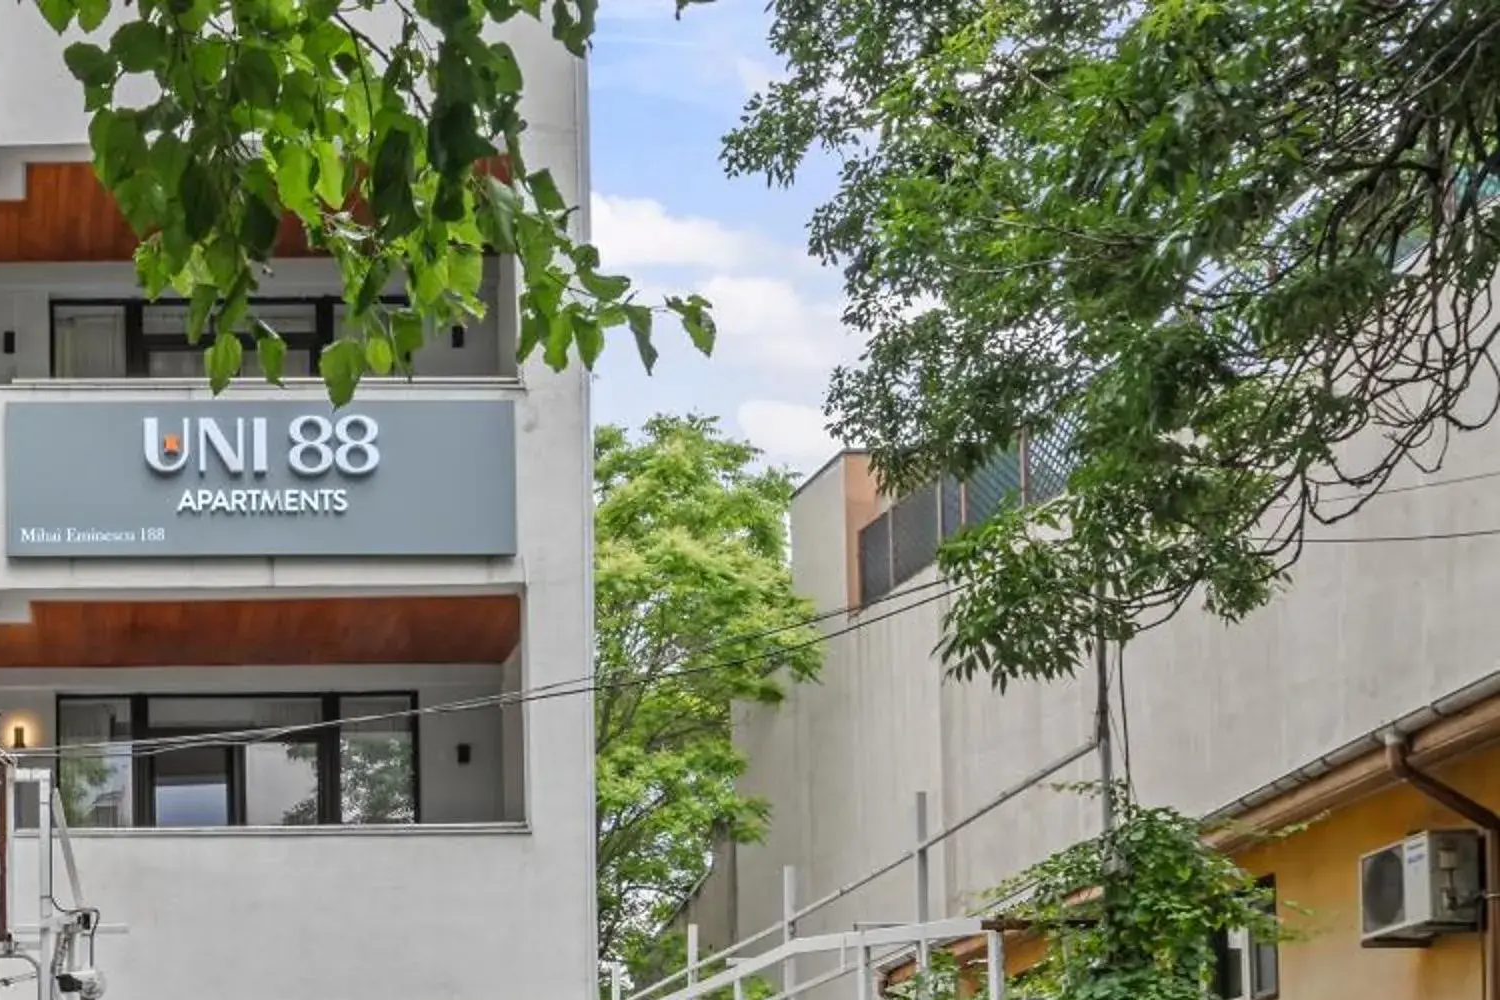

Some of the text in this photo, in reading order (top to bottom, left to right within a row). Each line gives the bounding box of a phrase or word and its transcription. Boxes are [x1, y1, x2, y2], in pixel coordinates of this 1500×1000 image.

[143, 414, 381, 475] UNI 88
[176, 488, 349, 512] APARTMENTS
[19, 527, 166, 543] Mihai Eminescu 188
